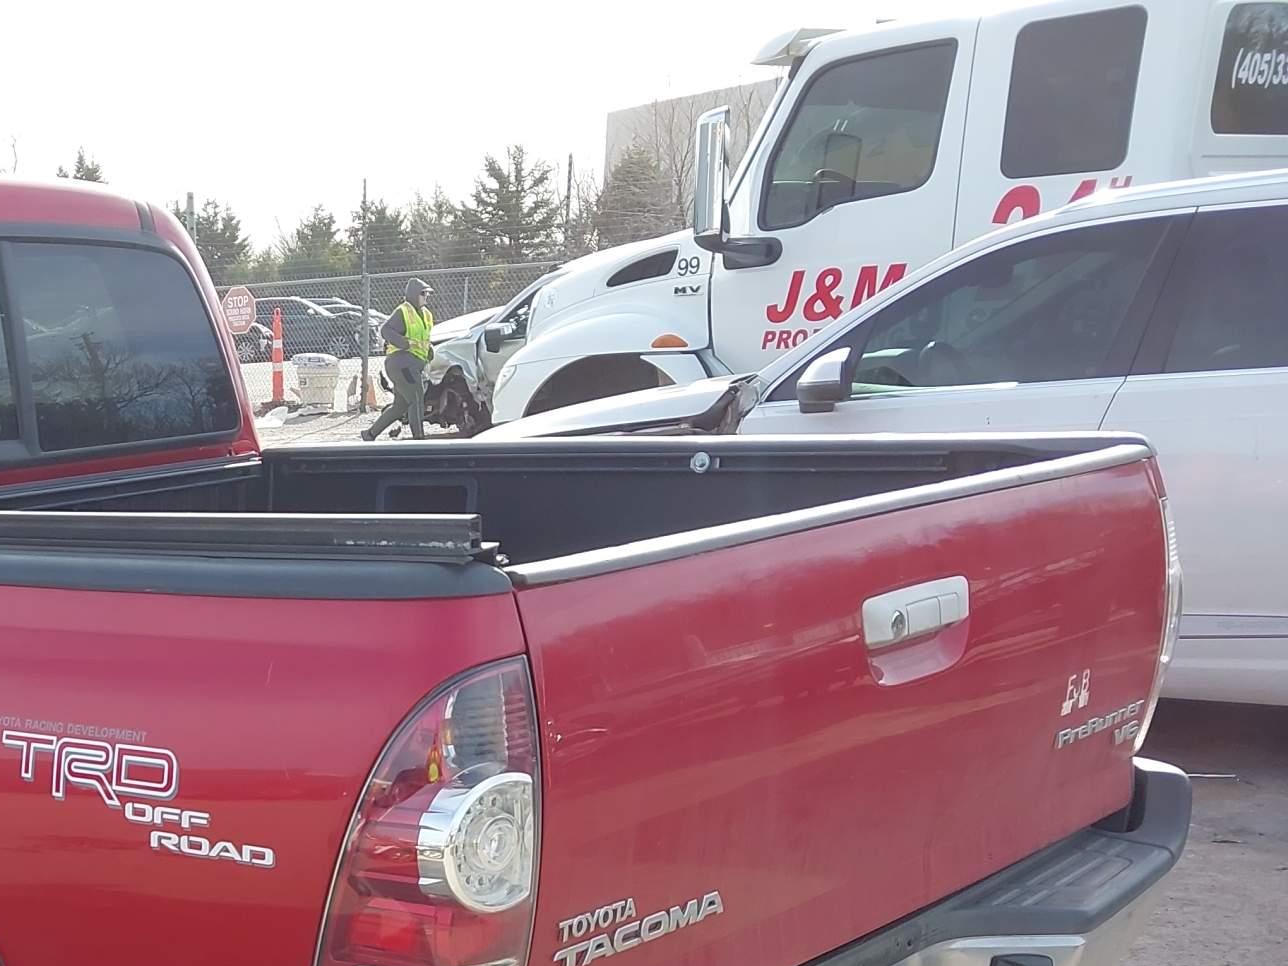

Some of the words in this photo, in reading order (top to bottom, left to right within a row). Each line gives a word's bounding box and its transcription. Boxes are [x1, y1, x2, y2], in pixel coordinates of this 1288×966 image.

[677, 256, 700, 277] 99
[227, 295, 249, 309] STOP
[673, 285, 702, 295] MV
[765, 262, 908, 324] J&M
[24, 718, 64, 733] RACING
[66, 723, 148, 743] DEVELOPMENT
[1055, 699, 1145, 749] PreRunner
[1113, 720, 1140, 746] V6
[2, 730, 179, 808] TRD
[123, 801, 211, 831] OFF
[149, 830, 276, 868] ROAD
[558, 898, 637, 943] TOYOTA
